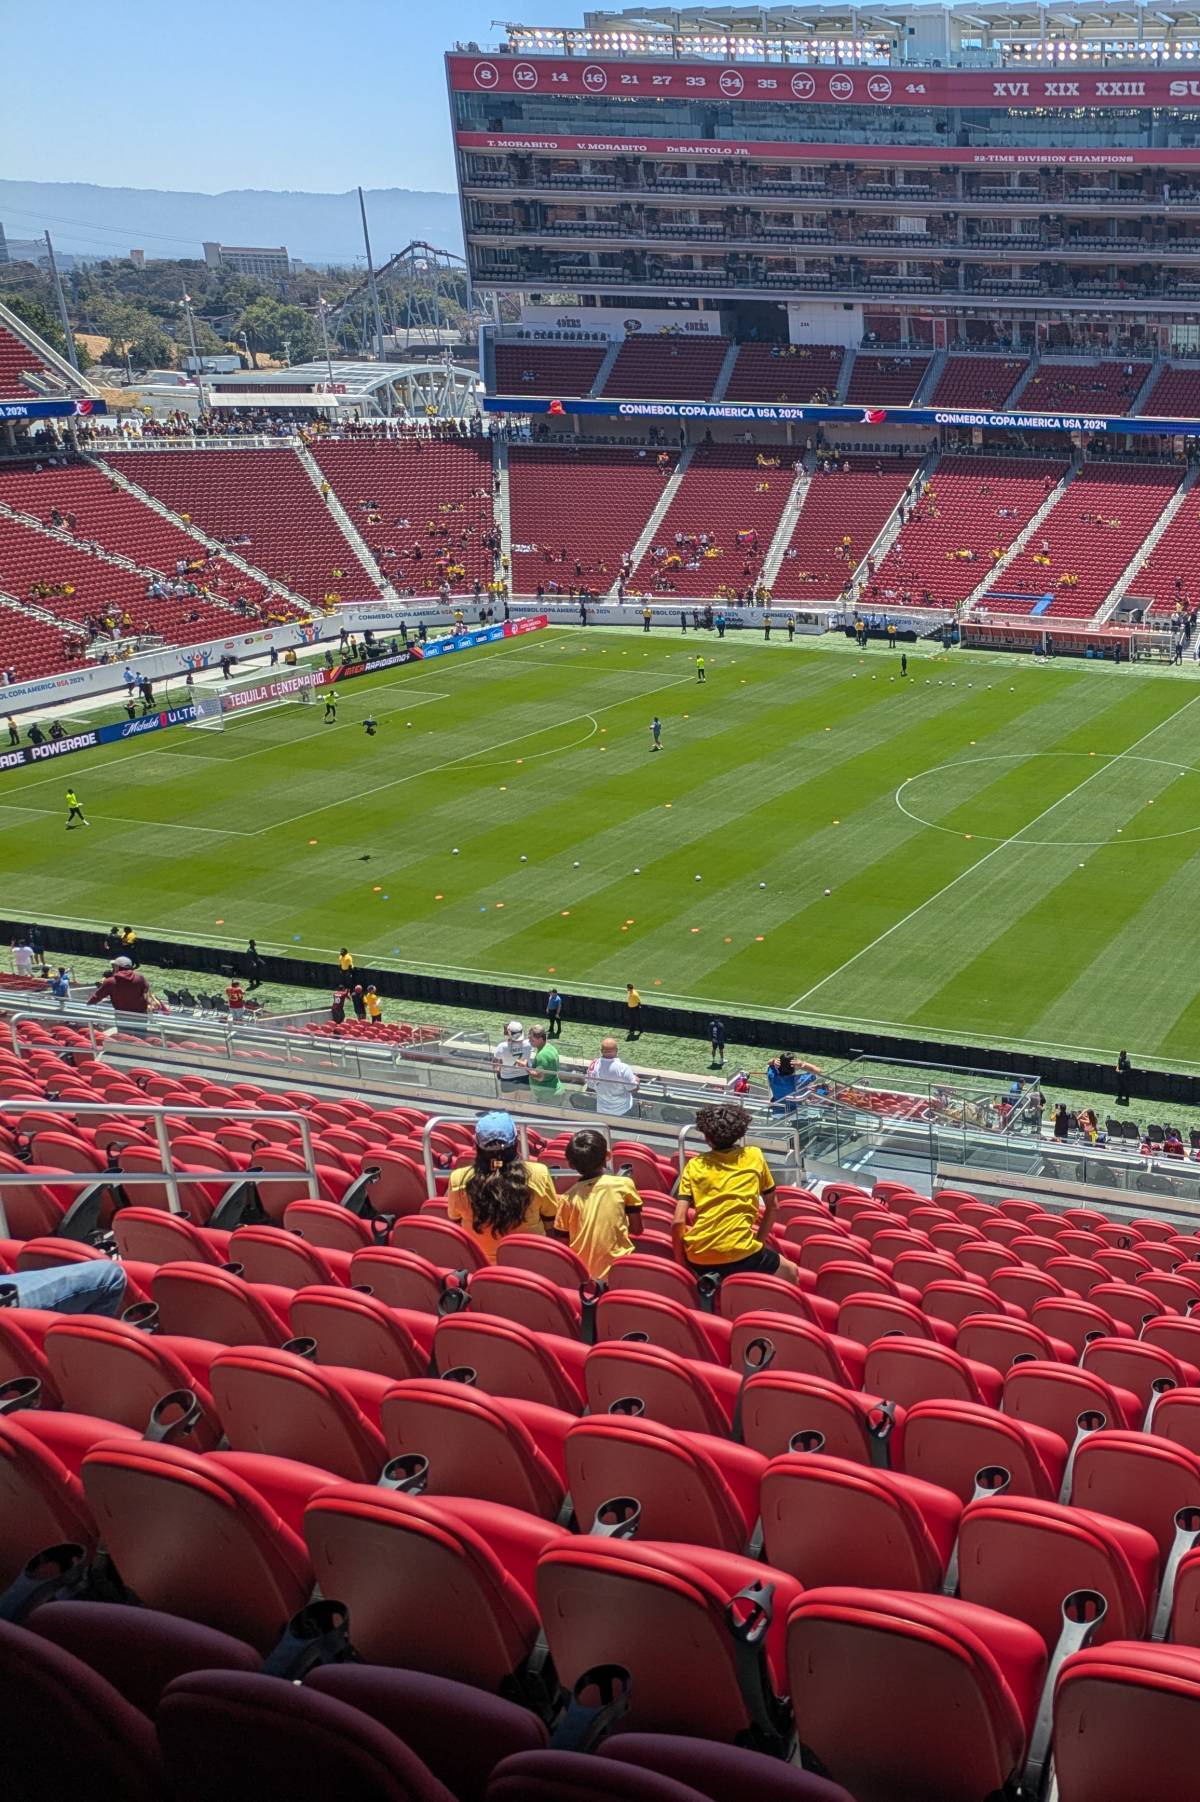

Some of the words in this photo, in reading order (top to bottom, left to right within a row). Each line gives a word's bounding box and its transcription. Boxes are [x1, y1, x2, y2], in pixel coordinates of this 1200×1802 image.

[481, 71, 491, 80] 8
[516, 71, 534, 81] 12
[552, 72, 568, 81] 14
[586, 74, 604, 83] 16
[621, 74, 639, 84] 21
[652, 75, 672, 85] 27
[686, 76, 706, 86] 33
[721, 78, 741, 88] 34
[757, 79, 777, 89] 35
[793, 80, 813, 90] 37
[831, 81, 851, 91] 39
[870, 83, 890, 93] 42
[905, 83, 926, 93] 44
[993, 82, 1029, 96] XVI
[1044, 82, 1079, 96] XIX
[1095, 82, 1145, 96] XXIII
[498, 141, 558, 149] MORABITO
[577, 143, 586, 151] V.
[586, 144, 647, 152] MORABITO
[1018, 155, 1066, 163] DIVISION
[1069, 155, 1134, 163] CHAMPIONS
[6, 407, 28, 416] 2024
[619, 404, 678, 416] CONMEBOL
[679, 407, 707, 417] COPA
[708, 408, 754, 418] AMERICA
[757, 408, 777, 419] USA
[779, 408, 804, 419] 2024
[935, 413, 989, 425] CONMEBOL
[990, 416, 1016, 426] COPA
[1016, 416, 1061, 428] AMERICA
[1063, 418, 1081, 429] USA
[1083, 419, 1107, 430] 2024
[358, 613, 394, 621] CONMEBOL
[395, 611, 412, 619] COPA
[413, 609, 440, 618] AMERICA
[9, 689, 26, 698] COPA
[27, 682, 57, 694] AMERICA
[69, 676, 85, 685] 2024
[229, 686, 268, 707] TEQUILA
[122, 715, 159, 737] Michelob
[168, 704, 205, 723] ULTRA
[31, 732, 97, 760] POWERADE
